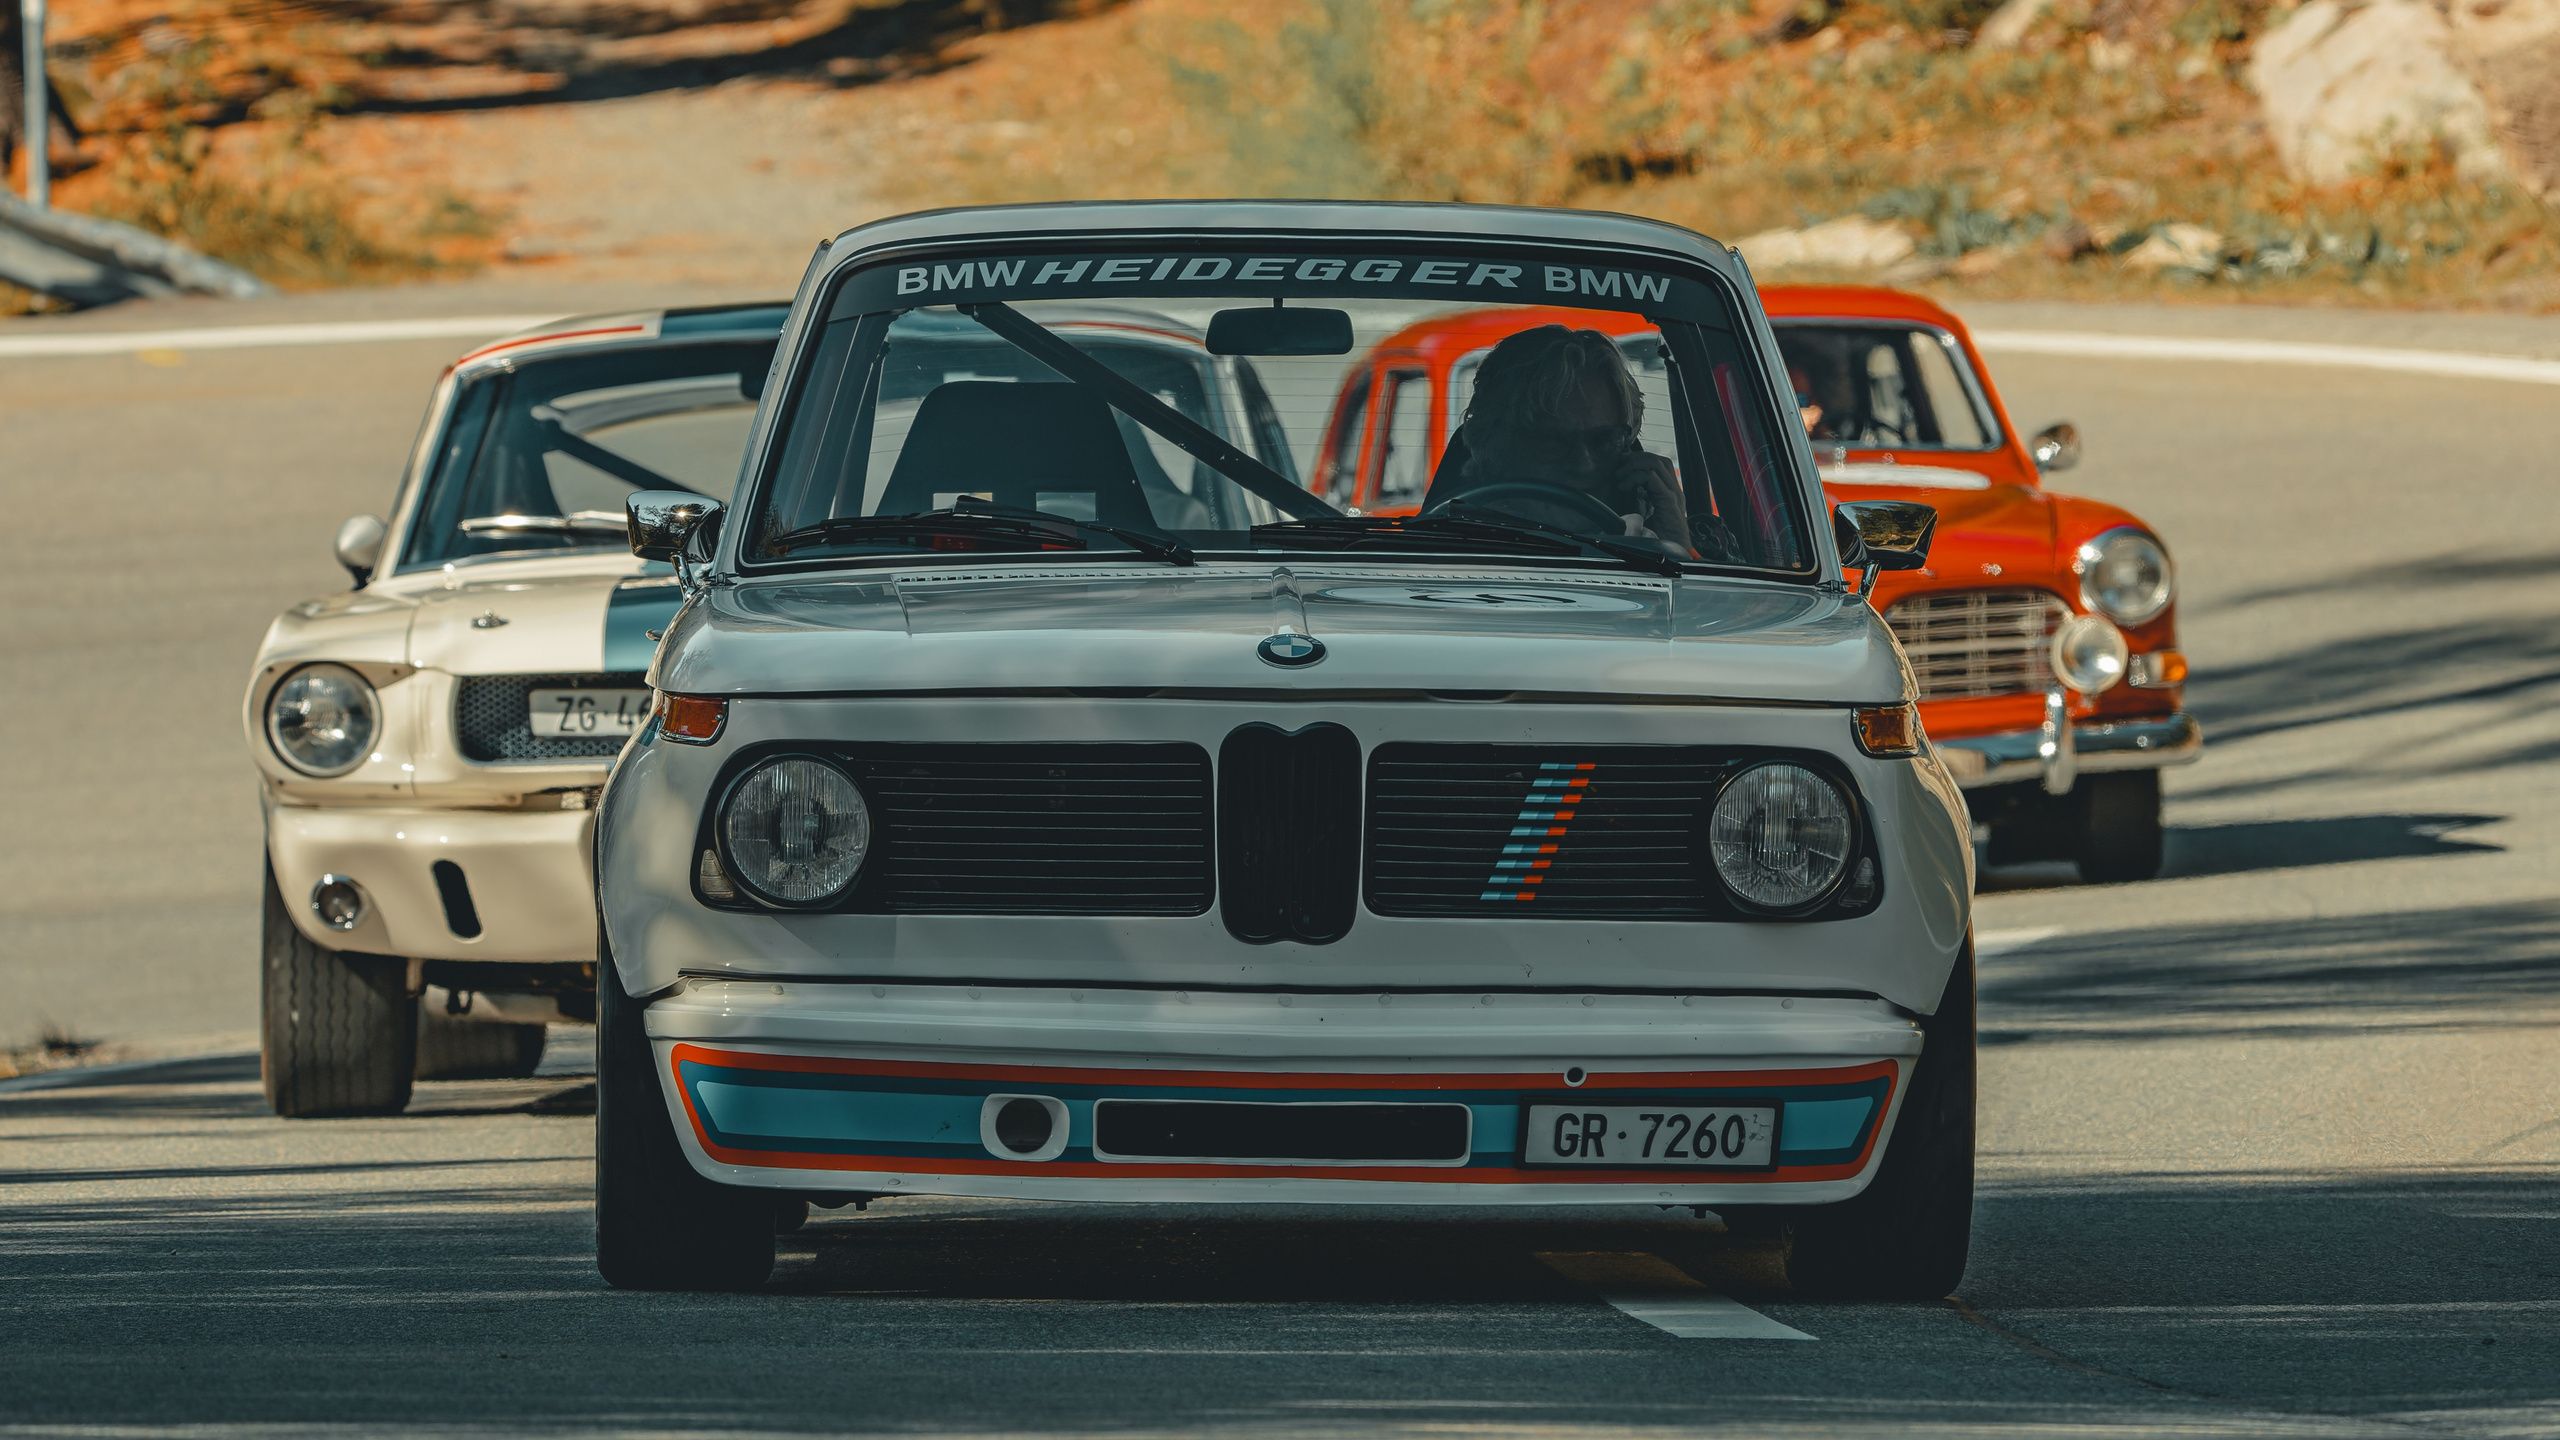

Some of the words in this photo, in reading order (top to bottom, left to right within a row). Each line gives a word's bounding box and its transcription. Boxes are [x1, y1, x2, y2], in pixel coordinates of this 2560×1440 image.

[897, 260, 1026, 295] BMW
[1031, 257, 1523, 288] HEIDEGGER
[1544, 265, 1671, 303] BMW
